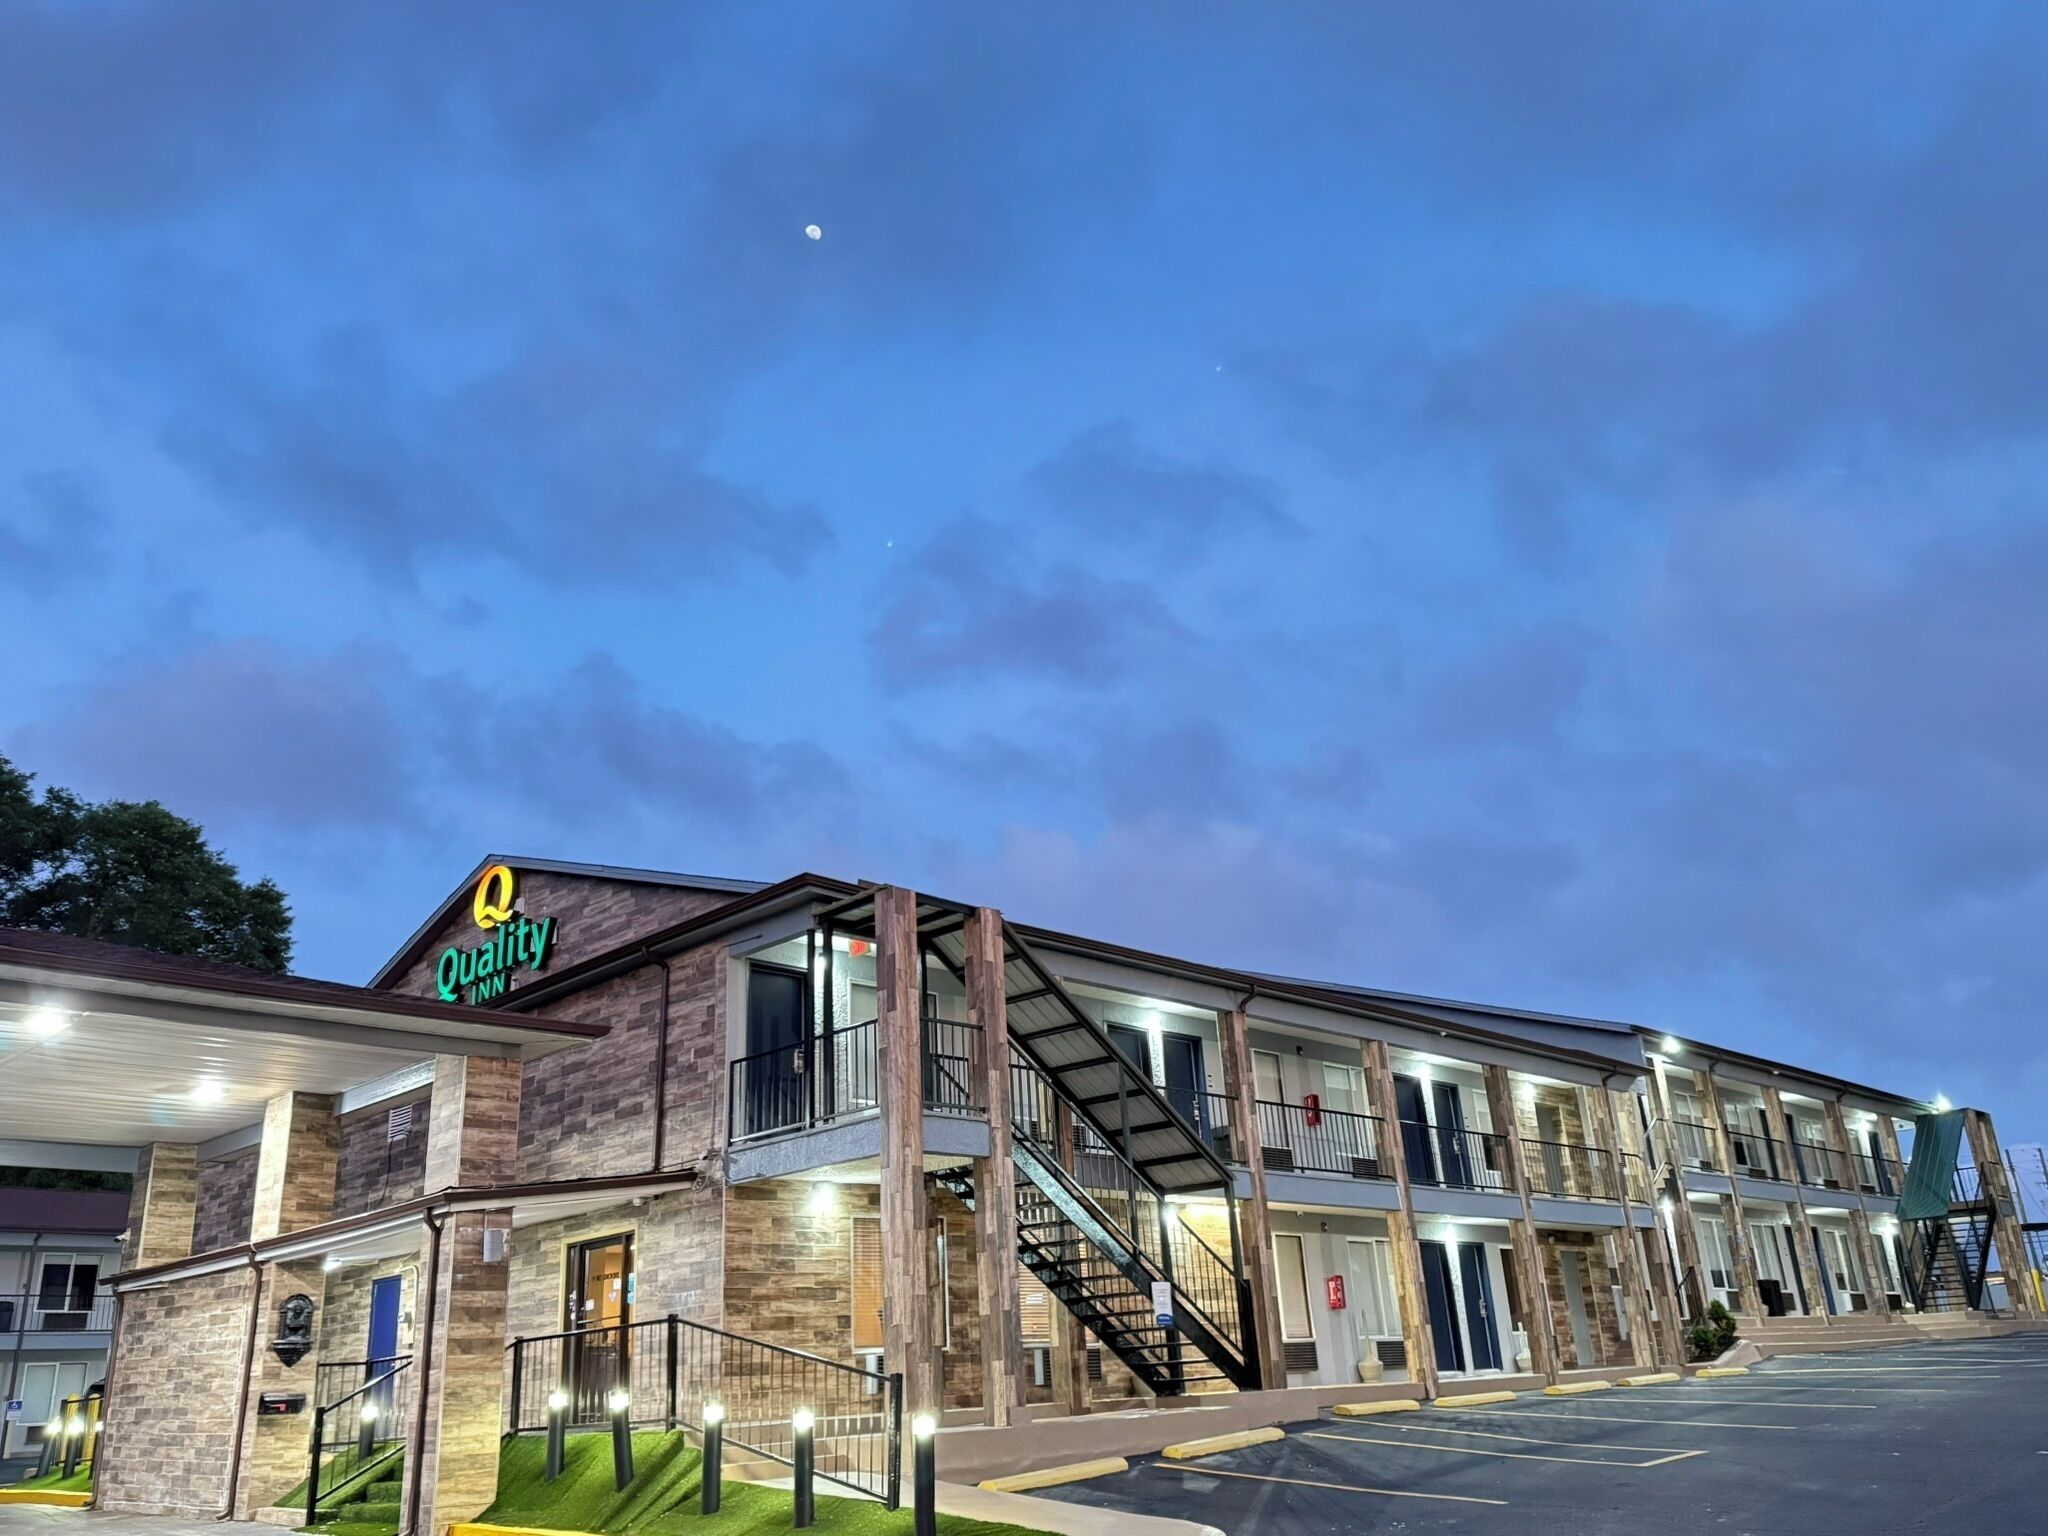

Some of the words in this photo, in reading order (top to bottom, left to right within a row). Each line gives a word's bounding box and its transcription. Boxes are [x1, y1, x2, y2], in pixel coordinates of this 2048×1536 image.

[474, 866, 513, 929] Q
[437, 917, 550, 1002] Quality
[471, 973, 505, 1005] INN
